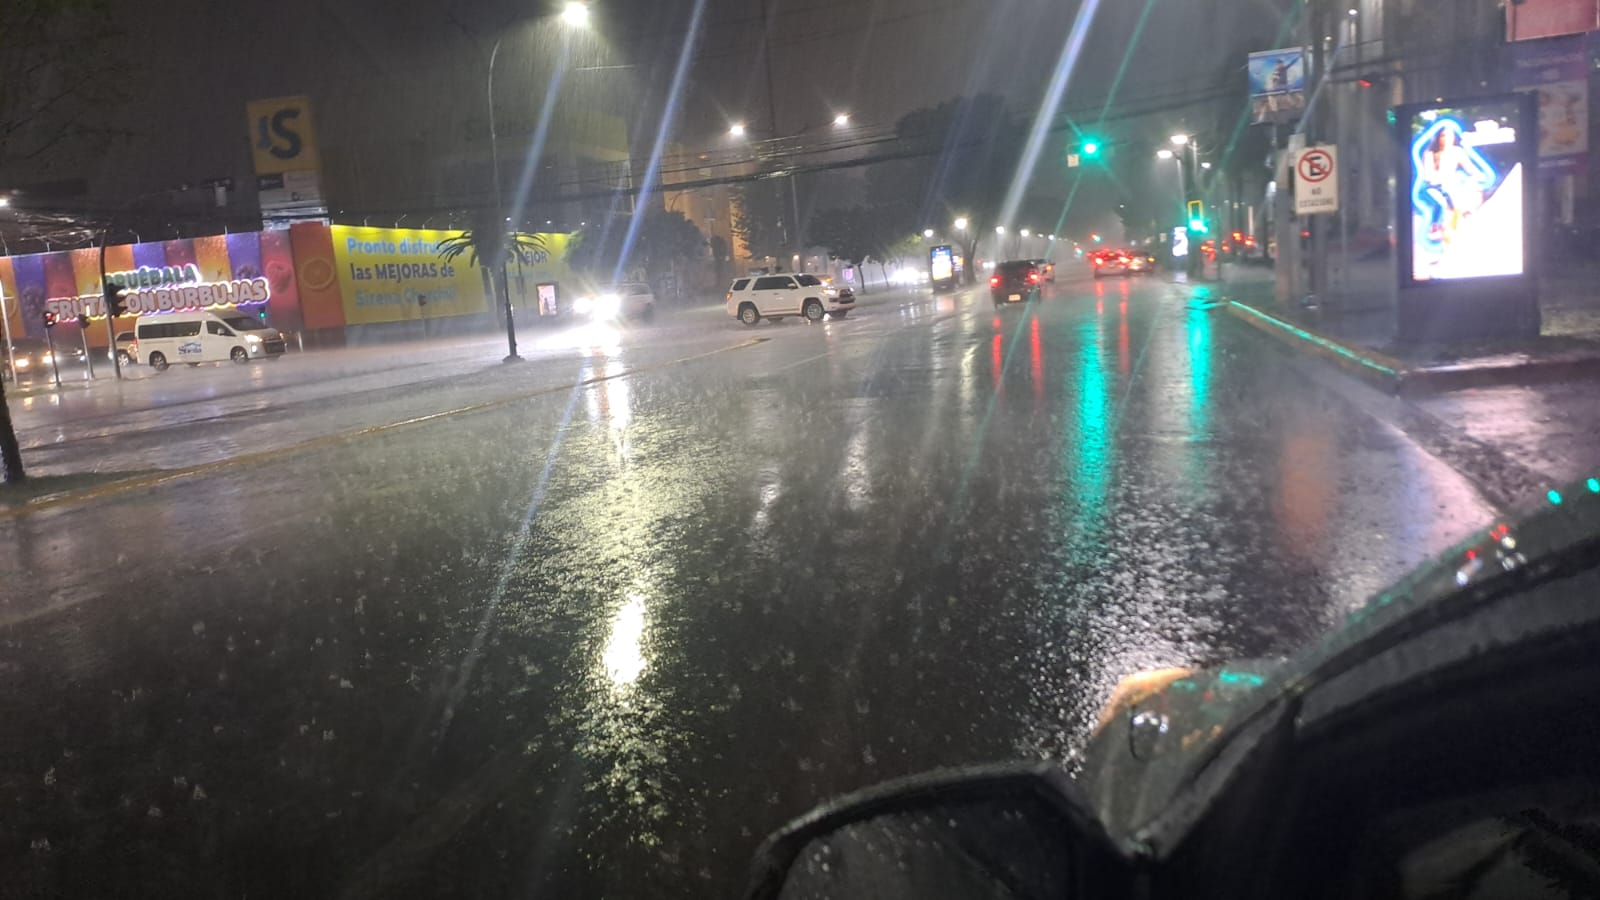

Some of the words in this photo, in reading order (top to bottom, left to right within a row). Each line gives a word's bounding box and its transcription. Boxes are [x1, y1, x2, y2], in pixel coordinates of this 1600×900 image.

[347, 237, 396, 255] Pronto
[350, 262, 371, 281] las
[375, 262, 437, 283] MEJORAS
[440, 262, 455, 279] de
[158, 280, 267, 311] BURBUJAS
